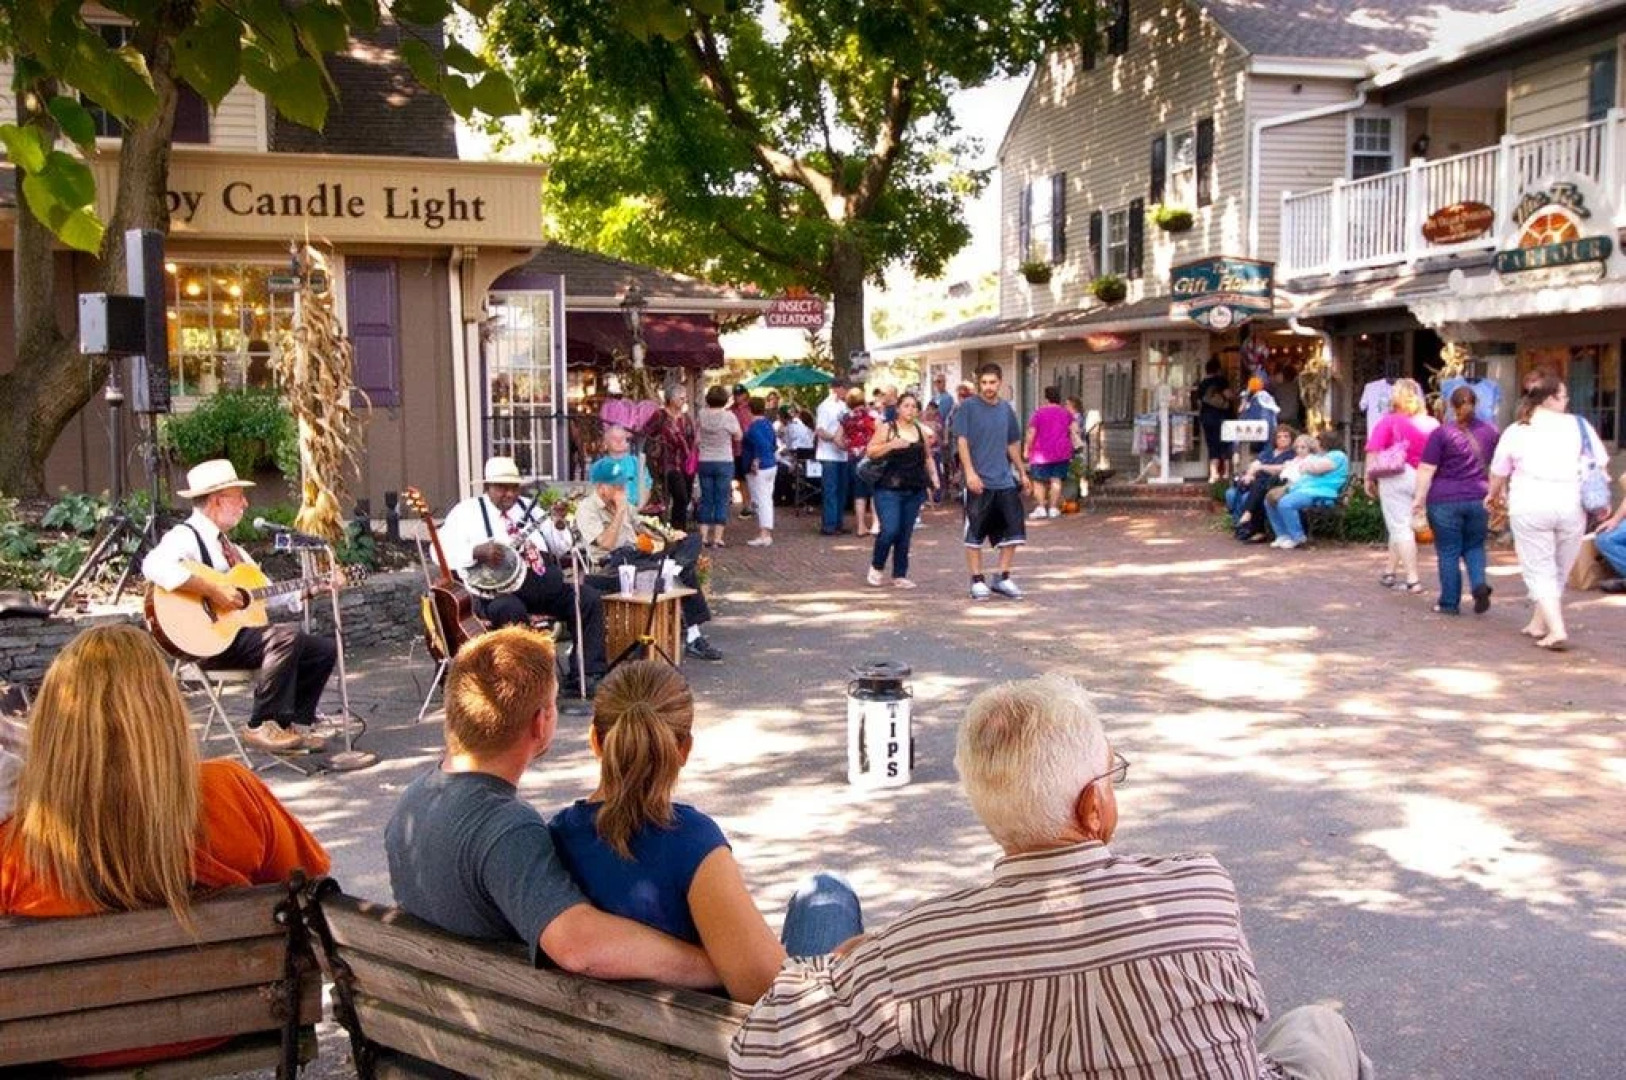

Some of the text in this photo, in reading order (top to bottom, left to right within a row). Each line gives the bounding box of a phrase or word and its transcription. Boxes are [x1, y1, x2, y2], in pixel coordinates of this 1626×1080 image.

[222, 180, 365, 218] Candle
[383, 186, 487, 229] Light
[1174, 277, 1208, 294] Gift
[777, 301, 812, 312] INSECT
[769, 314, 822, 325] CREATIONS
[886, 703, 899, 778] TIPS
